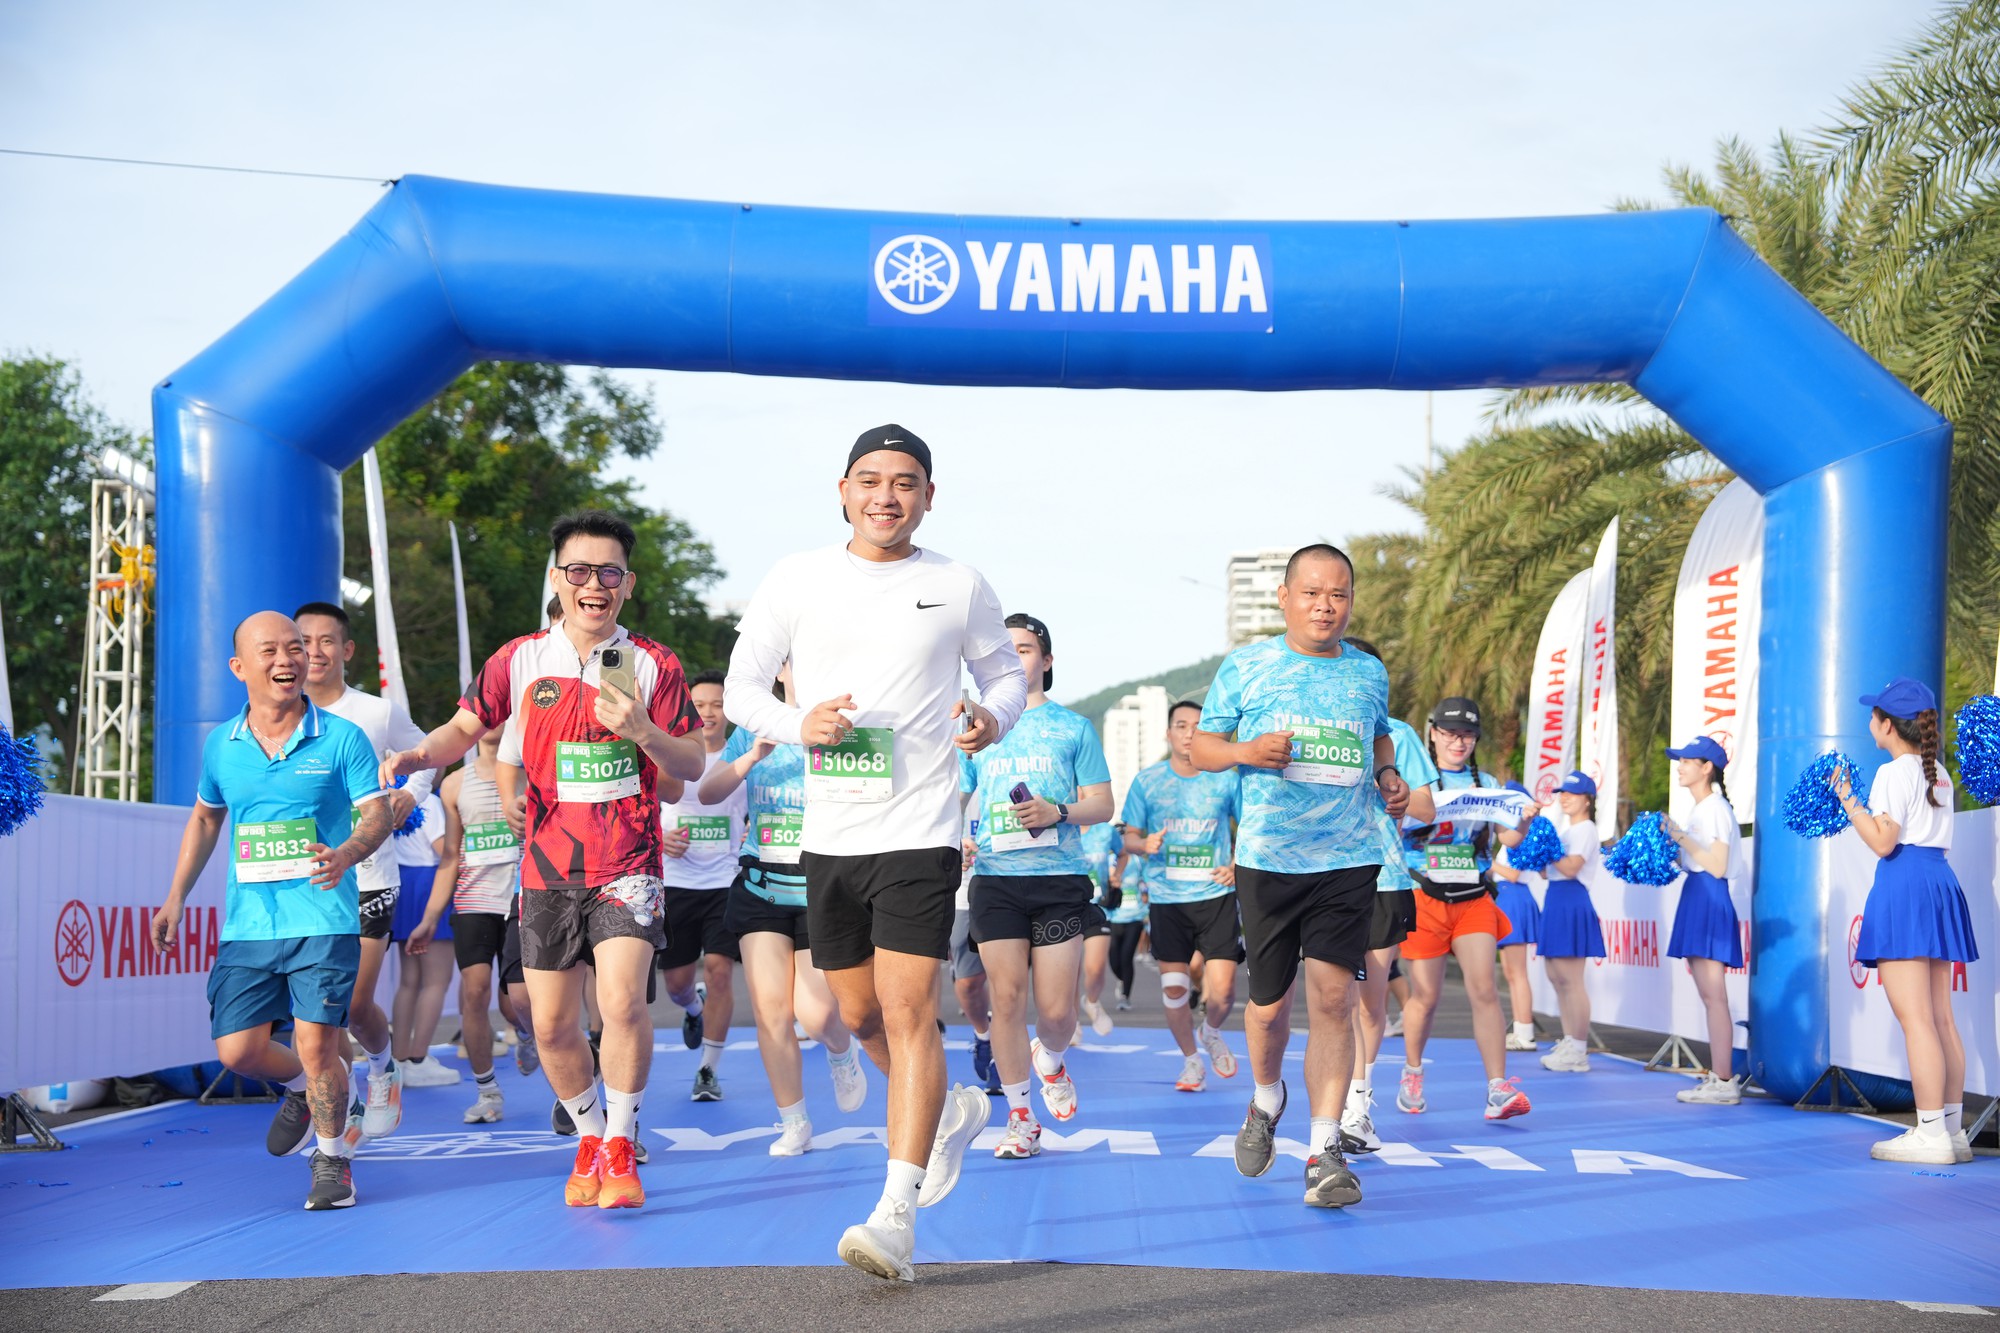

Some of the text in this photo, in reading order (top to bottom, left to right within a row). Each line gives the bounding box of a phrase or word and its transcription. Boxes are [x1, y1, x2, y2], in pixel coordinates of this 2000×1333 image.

[965, 241, 1268, 313] YAMAHA
[1703, 565, 1740, 726] YAMAHA
[1537, 648, 1568, 771] YAMAHA
[814, 752, 886, 773] F 51068
[1303, 743, 1362, 765] 50083
[562, 757, 633, 779] M 51072
[1463, 797, 1523, 816] UNIVERSIT
[477, 833, 514, 849] 51779
[691, 828, 727, 839] 51075
[241, 839, 310, 858] F 51833
[1179, 856, 1211, 867] 52977
[1440, 857, 1475, 868] 52091
[1606, 920, 1659, 968] YAMAHA
[1308, 1167, 1320, 1179] NIKE
